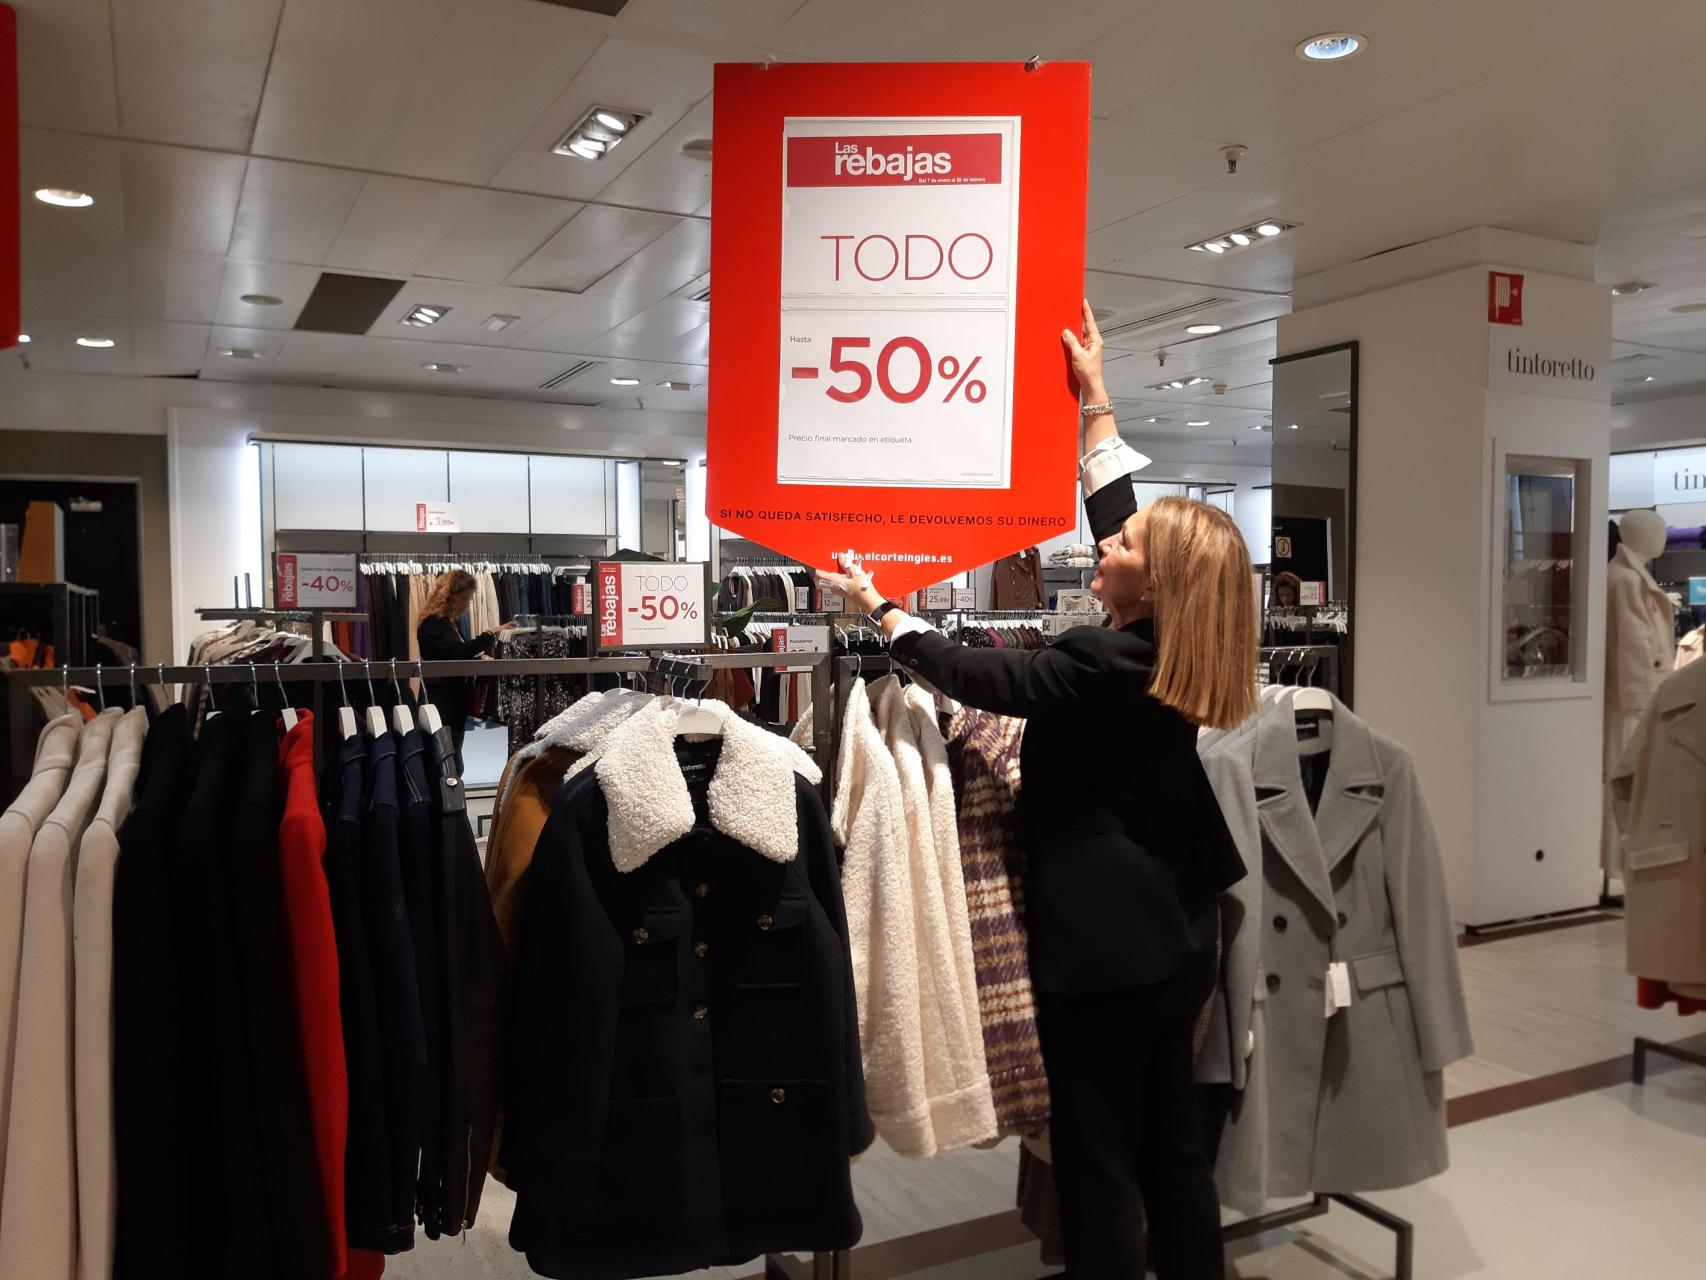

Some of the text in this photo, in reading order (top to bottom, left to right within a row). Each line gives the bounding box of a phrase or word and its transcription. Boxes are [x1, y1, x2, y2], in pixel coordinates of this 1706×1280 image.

[835, 142, 858, 154] Las
[835, 146, 952, 181] rebajas
[820, 232, 993, 282] TODO
[791, 336, 987, 404] -50%
[1506, 348, 1595, 382] tintoretto
[788, 434, 813, 442] Precio
[815, 434, 831, 443] final
[832, 435, 867, 443] marcado
[880, 436, 913, 445] etiqueta
[720, 509, 1066, 527] SI NO QUEDA SATISFECHO, LE DEVOLVEMOS SU DINERO
[831, 551, 953, 565] ww.elcorteingles.es
[282, 562, 296, 602] rebajas
[302, 575, 354, 592] -40%
[634, 575, 689, 592] TODO
[602, 575, 619, 636] rebajas
[628, 595, 698, 621] -50%
